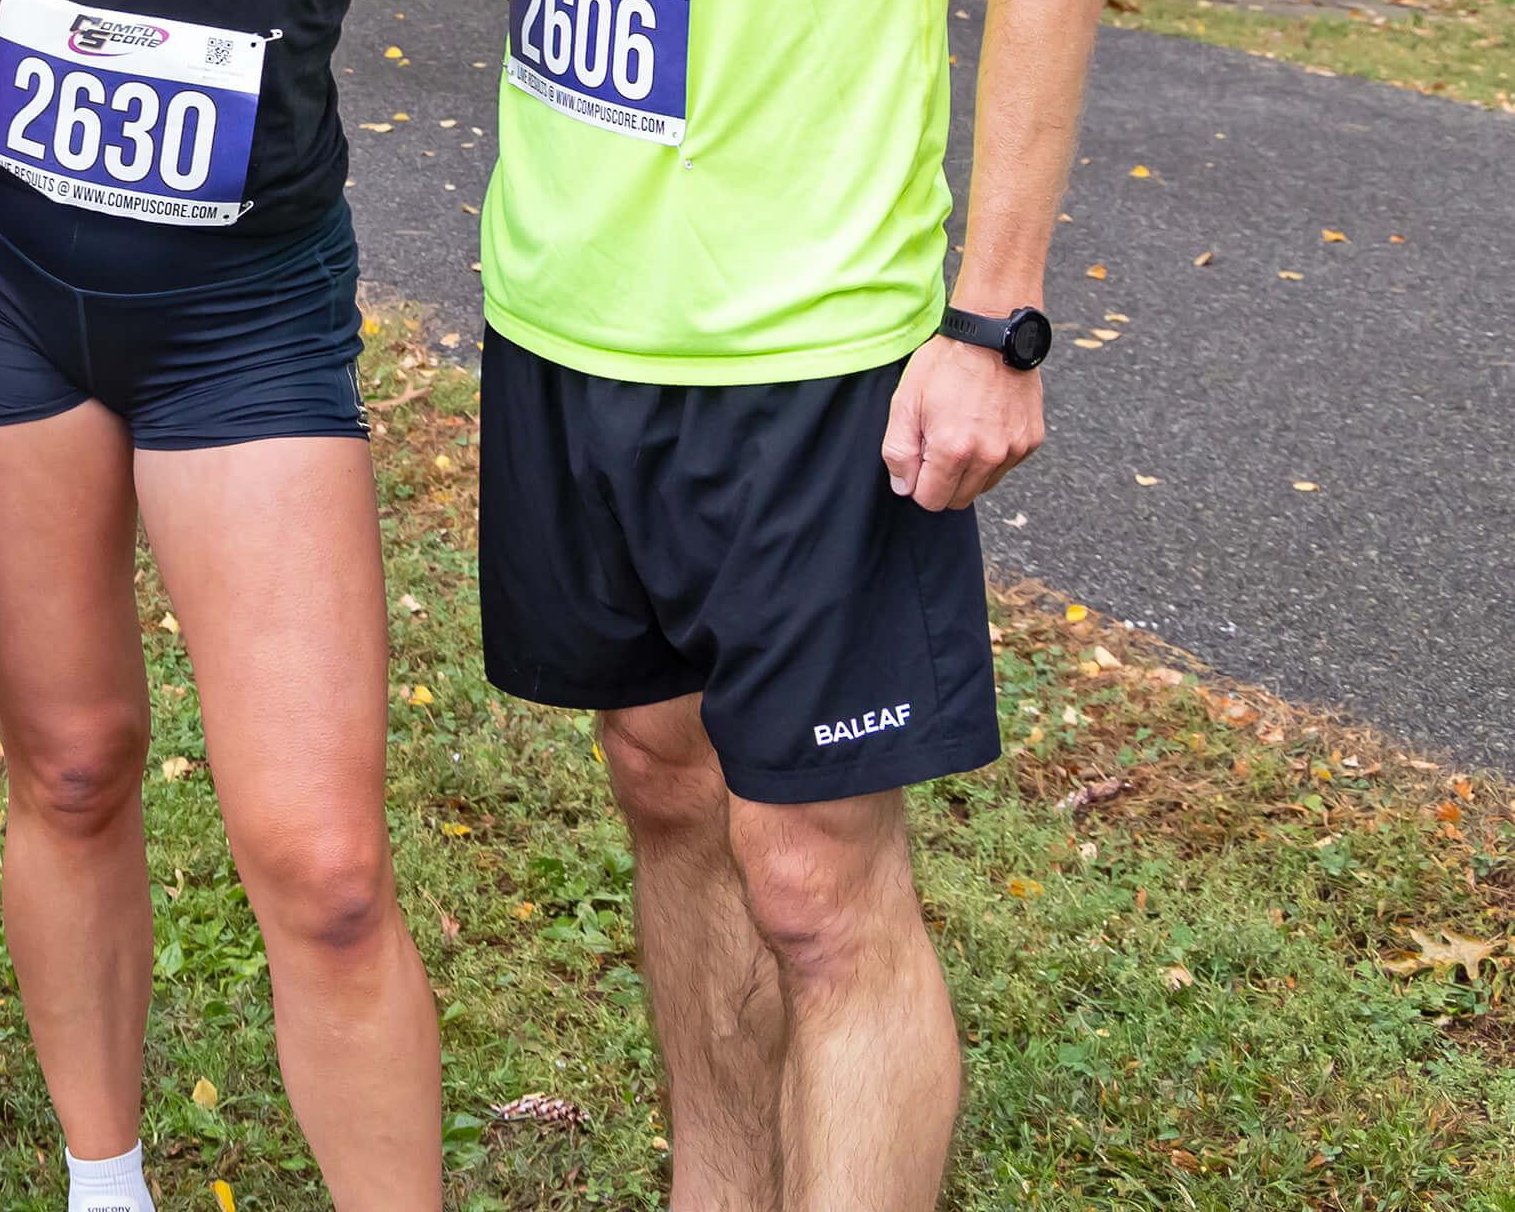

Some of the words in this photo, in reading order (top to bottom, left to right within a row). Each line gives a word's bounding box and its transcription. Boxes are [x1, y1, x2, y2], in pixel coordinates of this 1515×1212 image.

[69, 13, 159, 38] COMPU
[79, 28, 162, 49] SCORE
[5, 55, 218, 193] 2630
[517, 65, 528, 85] LIVE
[528, 71, 548, 97] RESULTS
[556, 88, 665, 135] WWW.COMPUSCORE.COM
[15, 165, 55, 193] RESULTS
[57, 180, 71, 198] @
[72, 183, 218, 220] WWW.COMPUSCORE.COM
[813, 703, 911, 746] BALEAF
